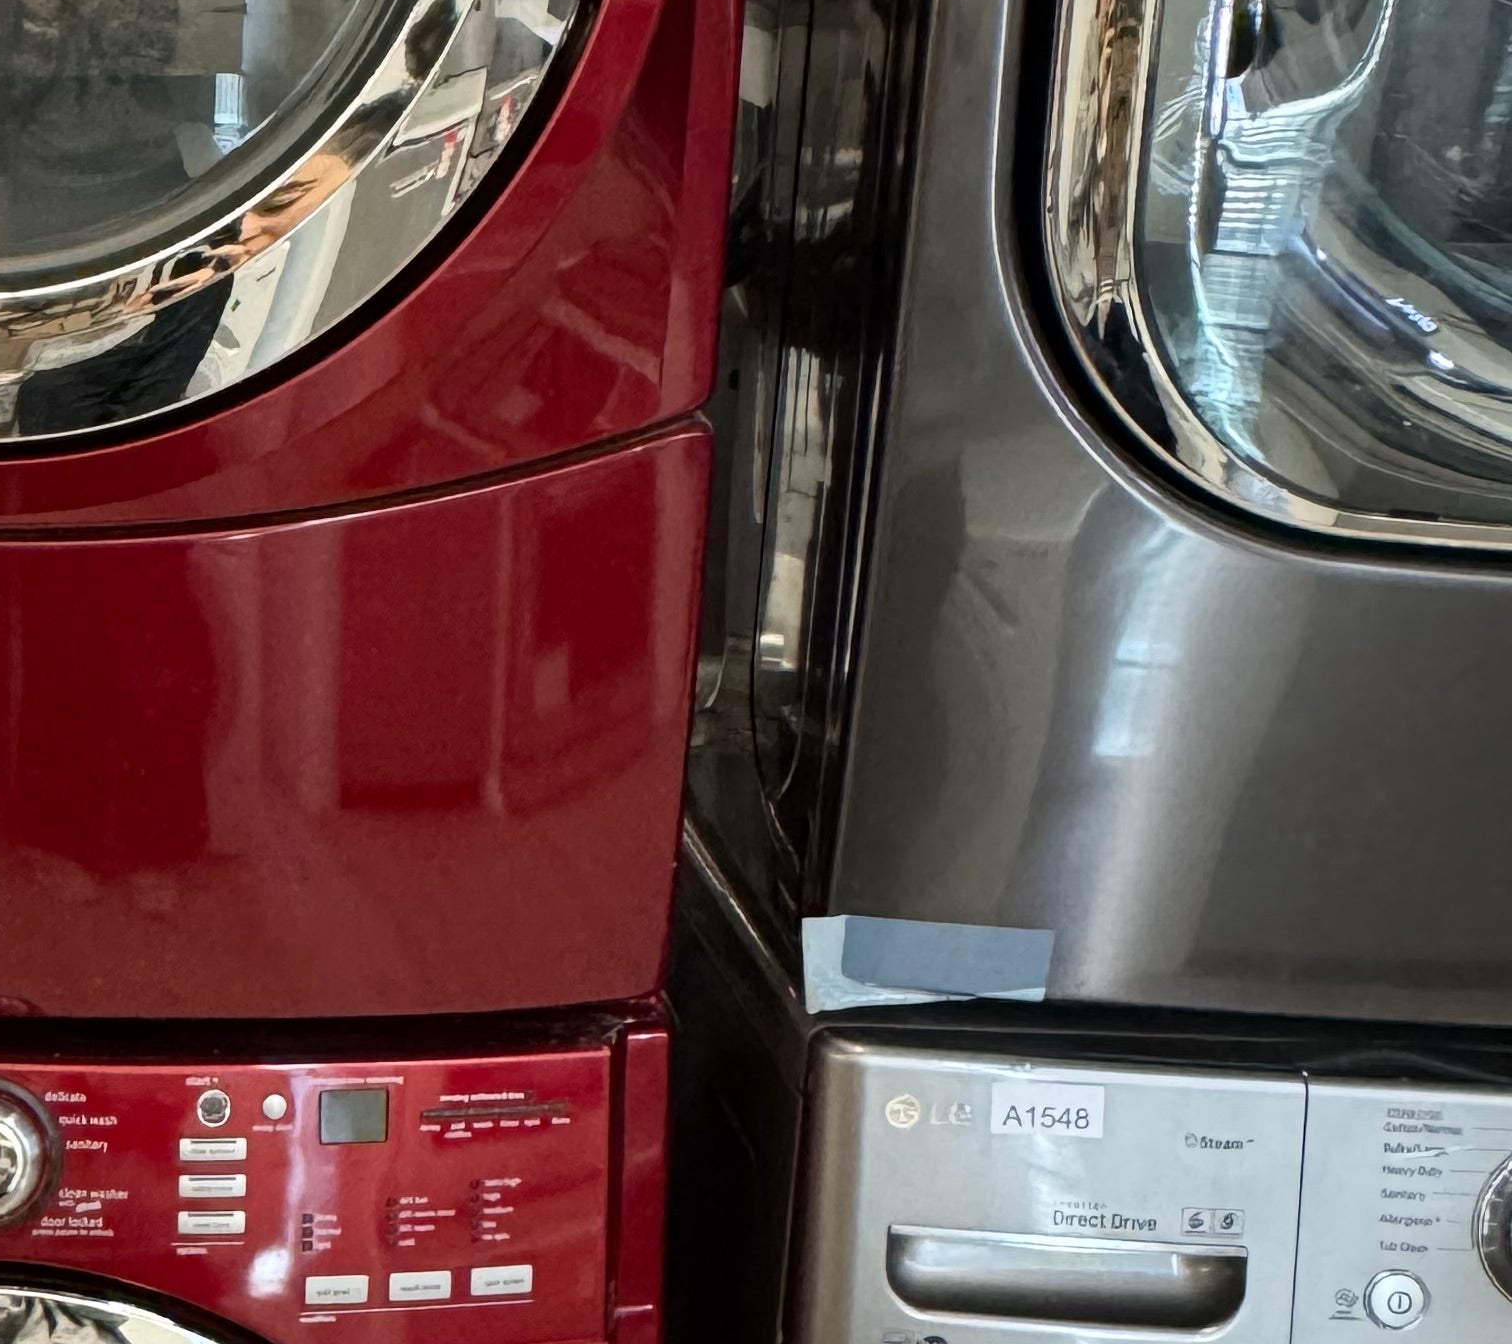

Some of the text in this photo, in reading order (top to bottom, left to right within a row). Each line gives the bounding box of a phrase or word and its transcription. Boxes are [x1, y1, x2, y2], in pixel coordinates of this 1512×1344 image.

[1002, 1104, 1091, 1130] A1548
[1053, 1210, 1158, 1232] Direct Drive
